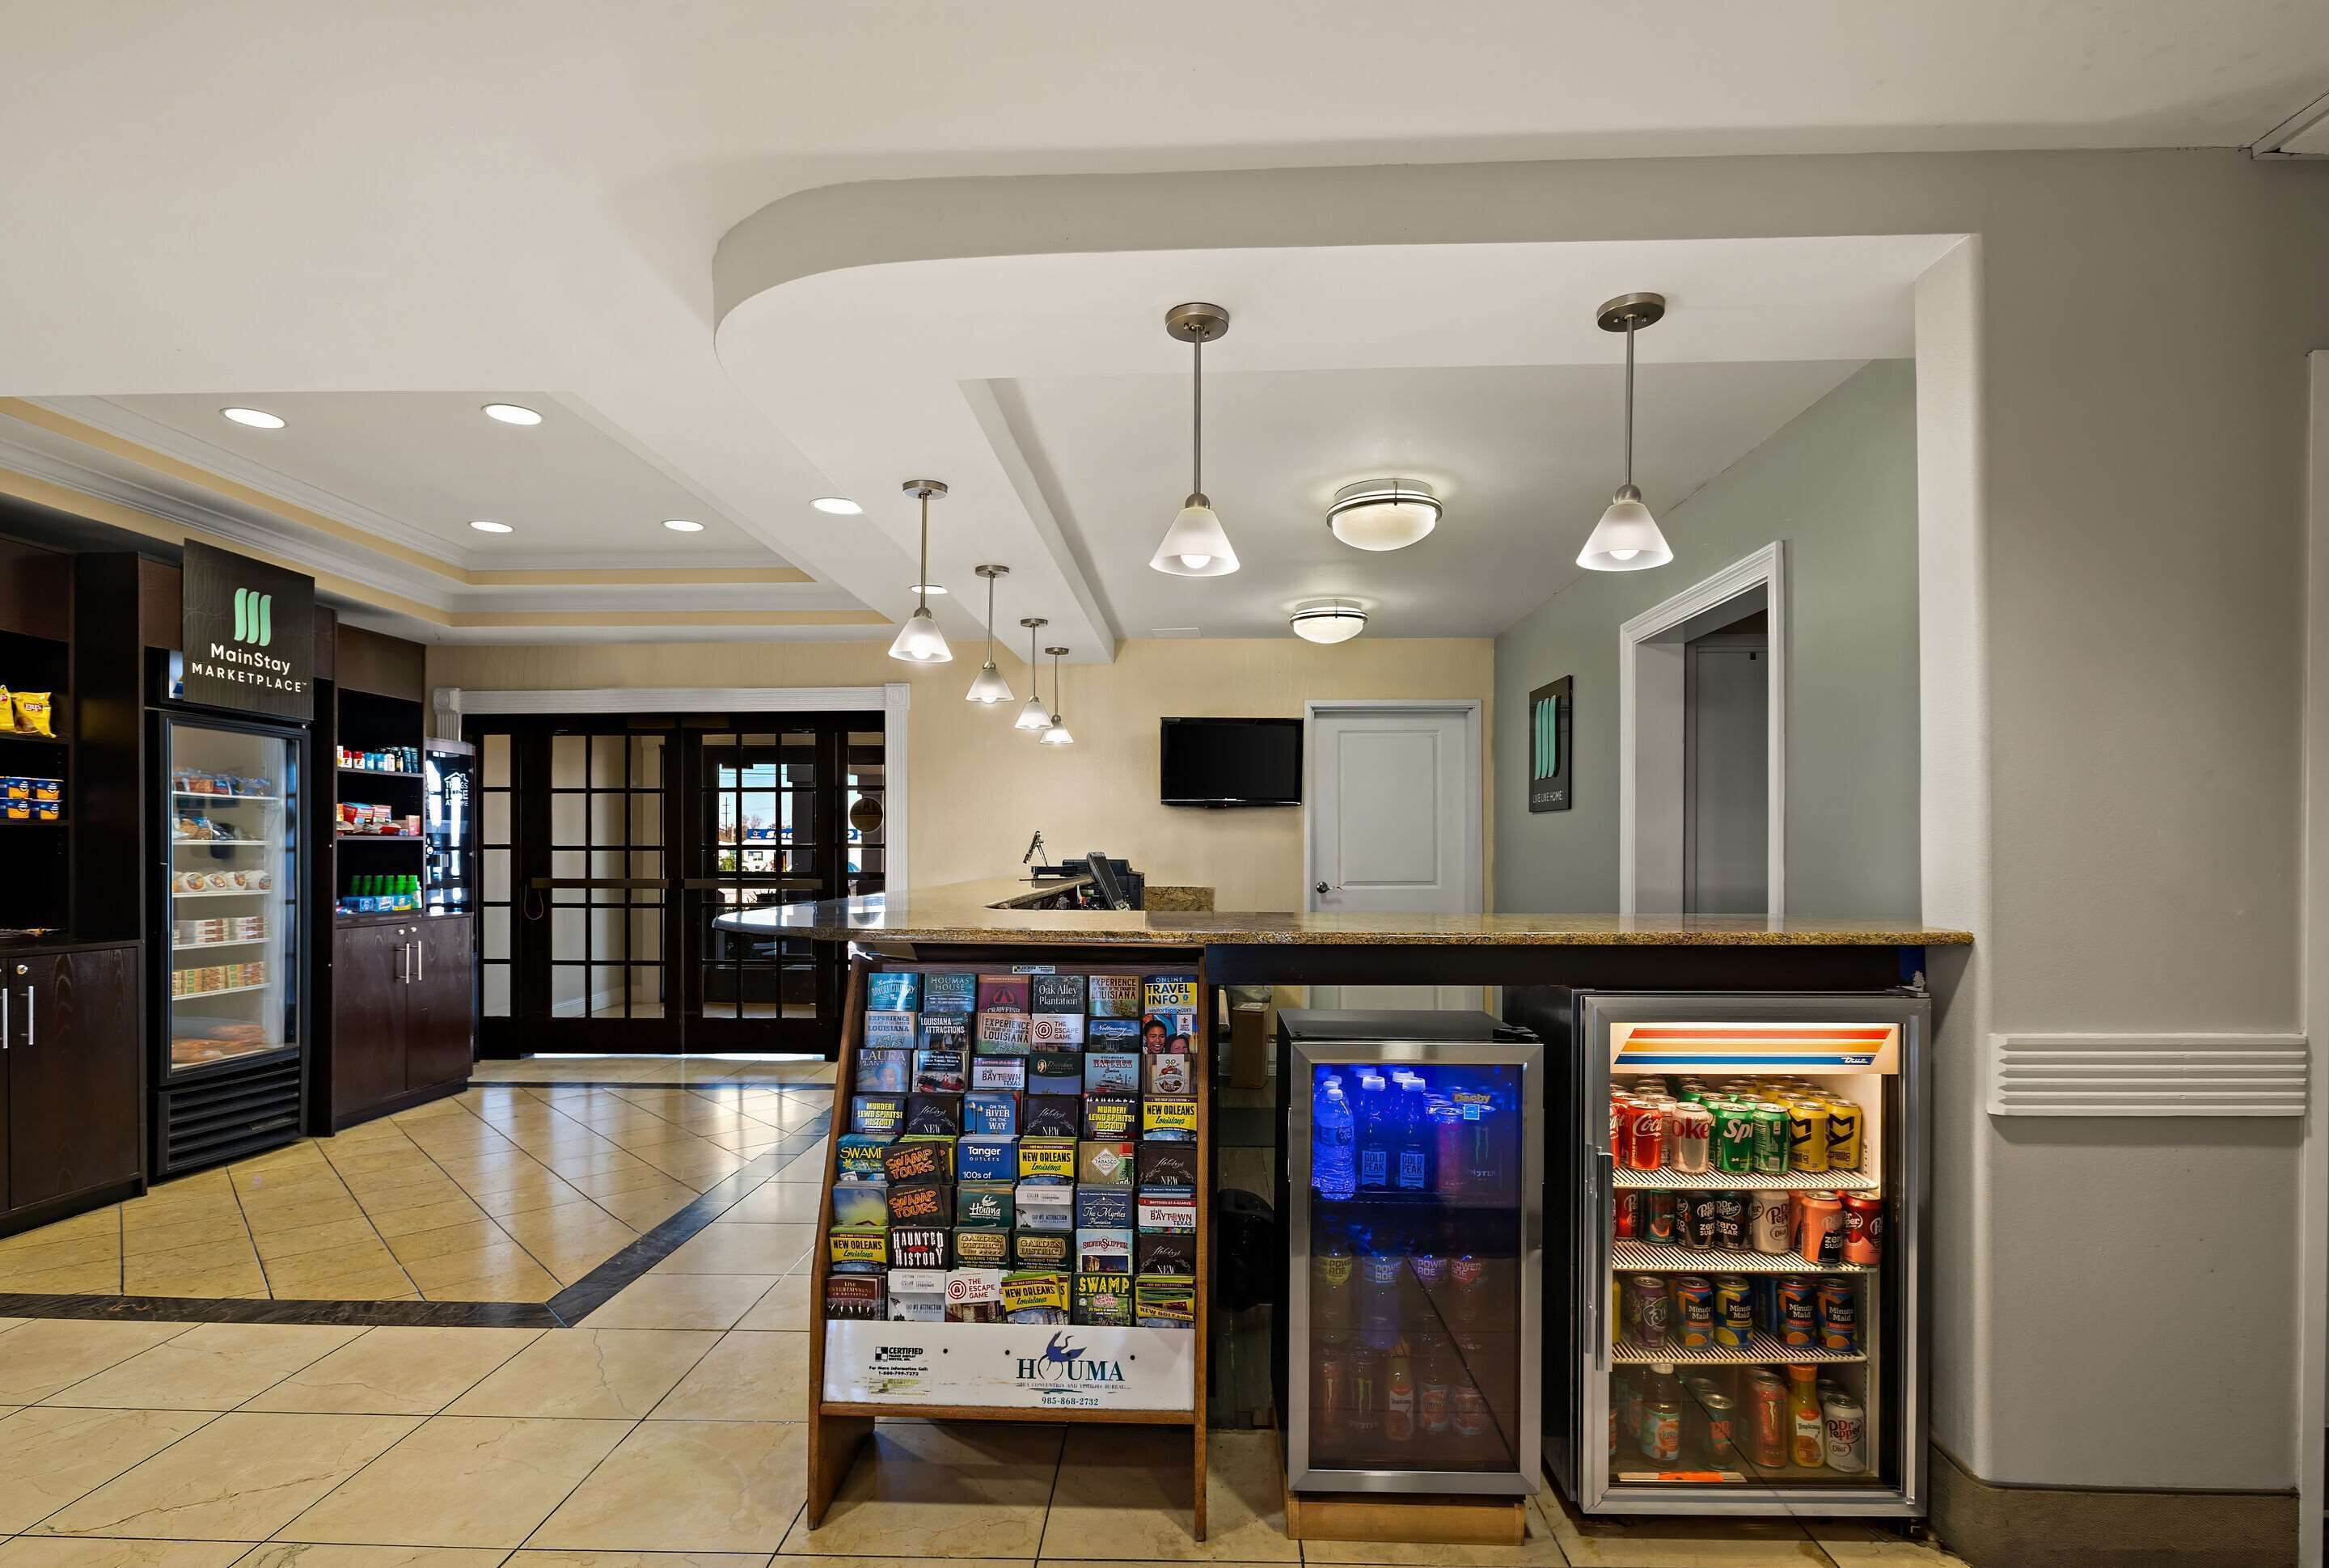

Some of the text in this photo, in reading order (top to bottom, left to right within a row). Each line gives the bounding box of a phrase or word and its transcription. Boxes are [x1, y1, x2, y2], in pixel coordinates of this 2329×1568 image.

[210, 643, 290, 675] MainStay
[1092, 978, 1137, 987] EXPERIENCE
[872, 983, 915, 995] BAYOU COURY
[1038, 984, 1078, 997] Oak Alley
[1147, 983, 1190, 994] TRAVEL
[1039, 995, 1078, 1006] Plantation
[1091, 991, 1136, 1000] LOUISIANA
[1148, 995, 1179, 1005] INFO
[920, 1017, 952, 1026] LOUISIANA
[985, 1017, 1030, 1030] EXPERIENCE
[924, 1025, 965, 1034] ATTRACTIONS
[983, 1030, 1029, 1043] LOUISIANA
[860, 1050, 906, 1061] LAURA
[1093, 1059, 1133, 1068] NATCHEZ
[982, 1073, 1021, 1082] BAYTOWN
[866, 1102, 894, 1110] MURDER!
[1097, 1105, 1126, 1114] MURDER!
[1147, 1105, 1195, 1115] NEW ORLEANS
[857, 1109, 903, 1119] LEWD SPIRITS!
[986, 1109, 1010, 1118] RIVER
[1088, 1114, 1135, 1122] LEWD SPIRITS!
[865, 1118, 894, 1126] HISTORY!
[1156, 1116, 1186, 1124] Louisiana
[924, 1123, 941, 1133] NEW
[988, 1122, 1007, 1131] WAY
[1042, 1126, 1060, 1136] NEW
[1096, 1122, 1126, 1131] HISTORY!
[1672, 1117, 1710, 1139] oke
[967, 1146, 1001, 1157] Tanger
[886, 1149, 933, 1170] SWAMP
[1022, 1152, 1072, 1163] NEW ORLEANS
[1363, 1152, 1385, 1163] GOLD
[1401, 1154, 1422, 1164] GOLD
[891, 1160, 935, 1180] TOURS
[1031, 1162, 1062, 1171] Louisiana
[1364, 1162, 1384, 1172] PEAK
[1401, 1164, 1424, 1175] PEAK
[962, 1171, 991, 1179] 100s of
[1160, 1175, 1178, 1186] NEW
[889, 1190, 936, 1209] SWAMP
[893, 1201, 939, 1219] TOURS
[969, 1202, 1001, 1216] Houma
[1082, 1206, 1126, 1219] The Myrtles
[1150, 1213, 1192, 1222] BAYTOWN
[833, 1240, 883, 1250] NEW ORLEANS
[892, 1231, 945, 1249] HAUNTED
[1021, 1240, 1063, 1248] GARDEN
[843, 1249, 873, 1257] Louisiana
[894, 1247, 945, 1267] HISTORY
[1020, 1248, 1063, 1256] DISTRICT
[1418, 1259, 1447, 1268] POWER
[1452, 1262, 1482, 1271] POWER
[1156, 1265, 1175, 1274] NEW
[1329, 1267, 1346, 1275] ADE
[1418, 1268, 1435, 1276] ADE
[1452, 1268, 1468, 1277] ADE
[1376, 1272, 1393, 1281] ADE
[1078, 1276, 1131, 1294] SWAMP
[1004, 1285, 1055, 1298] NEW ORLEANS
[1016, 1296, 1048, 1305] Louisiana
[1139, 1306, 1157, 1315] NEW
[1692, 1312, 1709, 1320] Maid
[888, 1346, 924, 1355] CERTIFIED
[1016, 1354, 1126, 1382] HOUMA
[1042, 1397, 1099, 1405] 985-868-2732
[1797, 1422, 1820, 1431] Tropicana
[1828, 1419, 1860, 1440] Pepper
[1837, 1419, 1853, 1430] Dr
[1832, 1444, 1846, 1453] Diet
